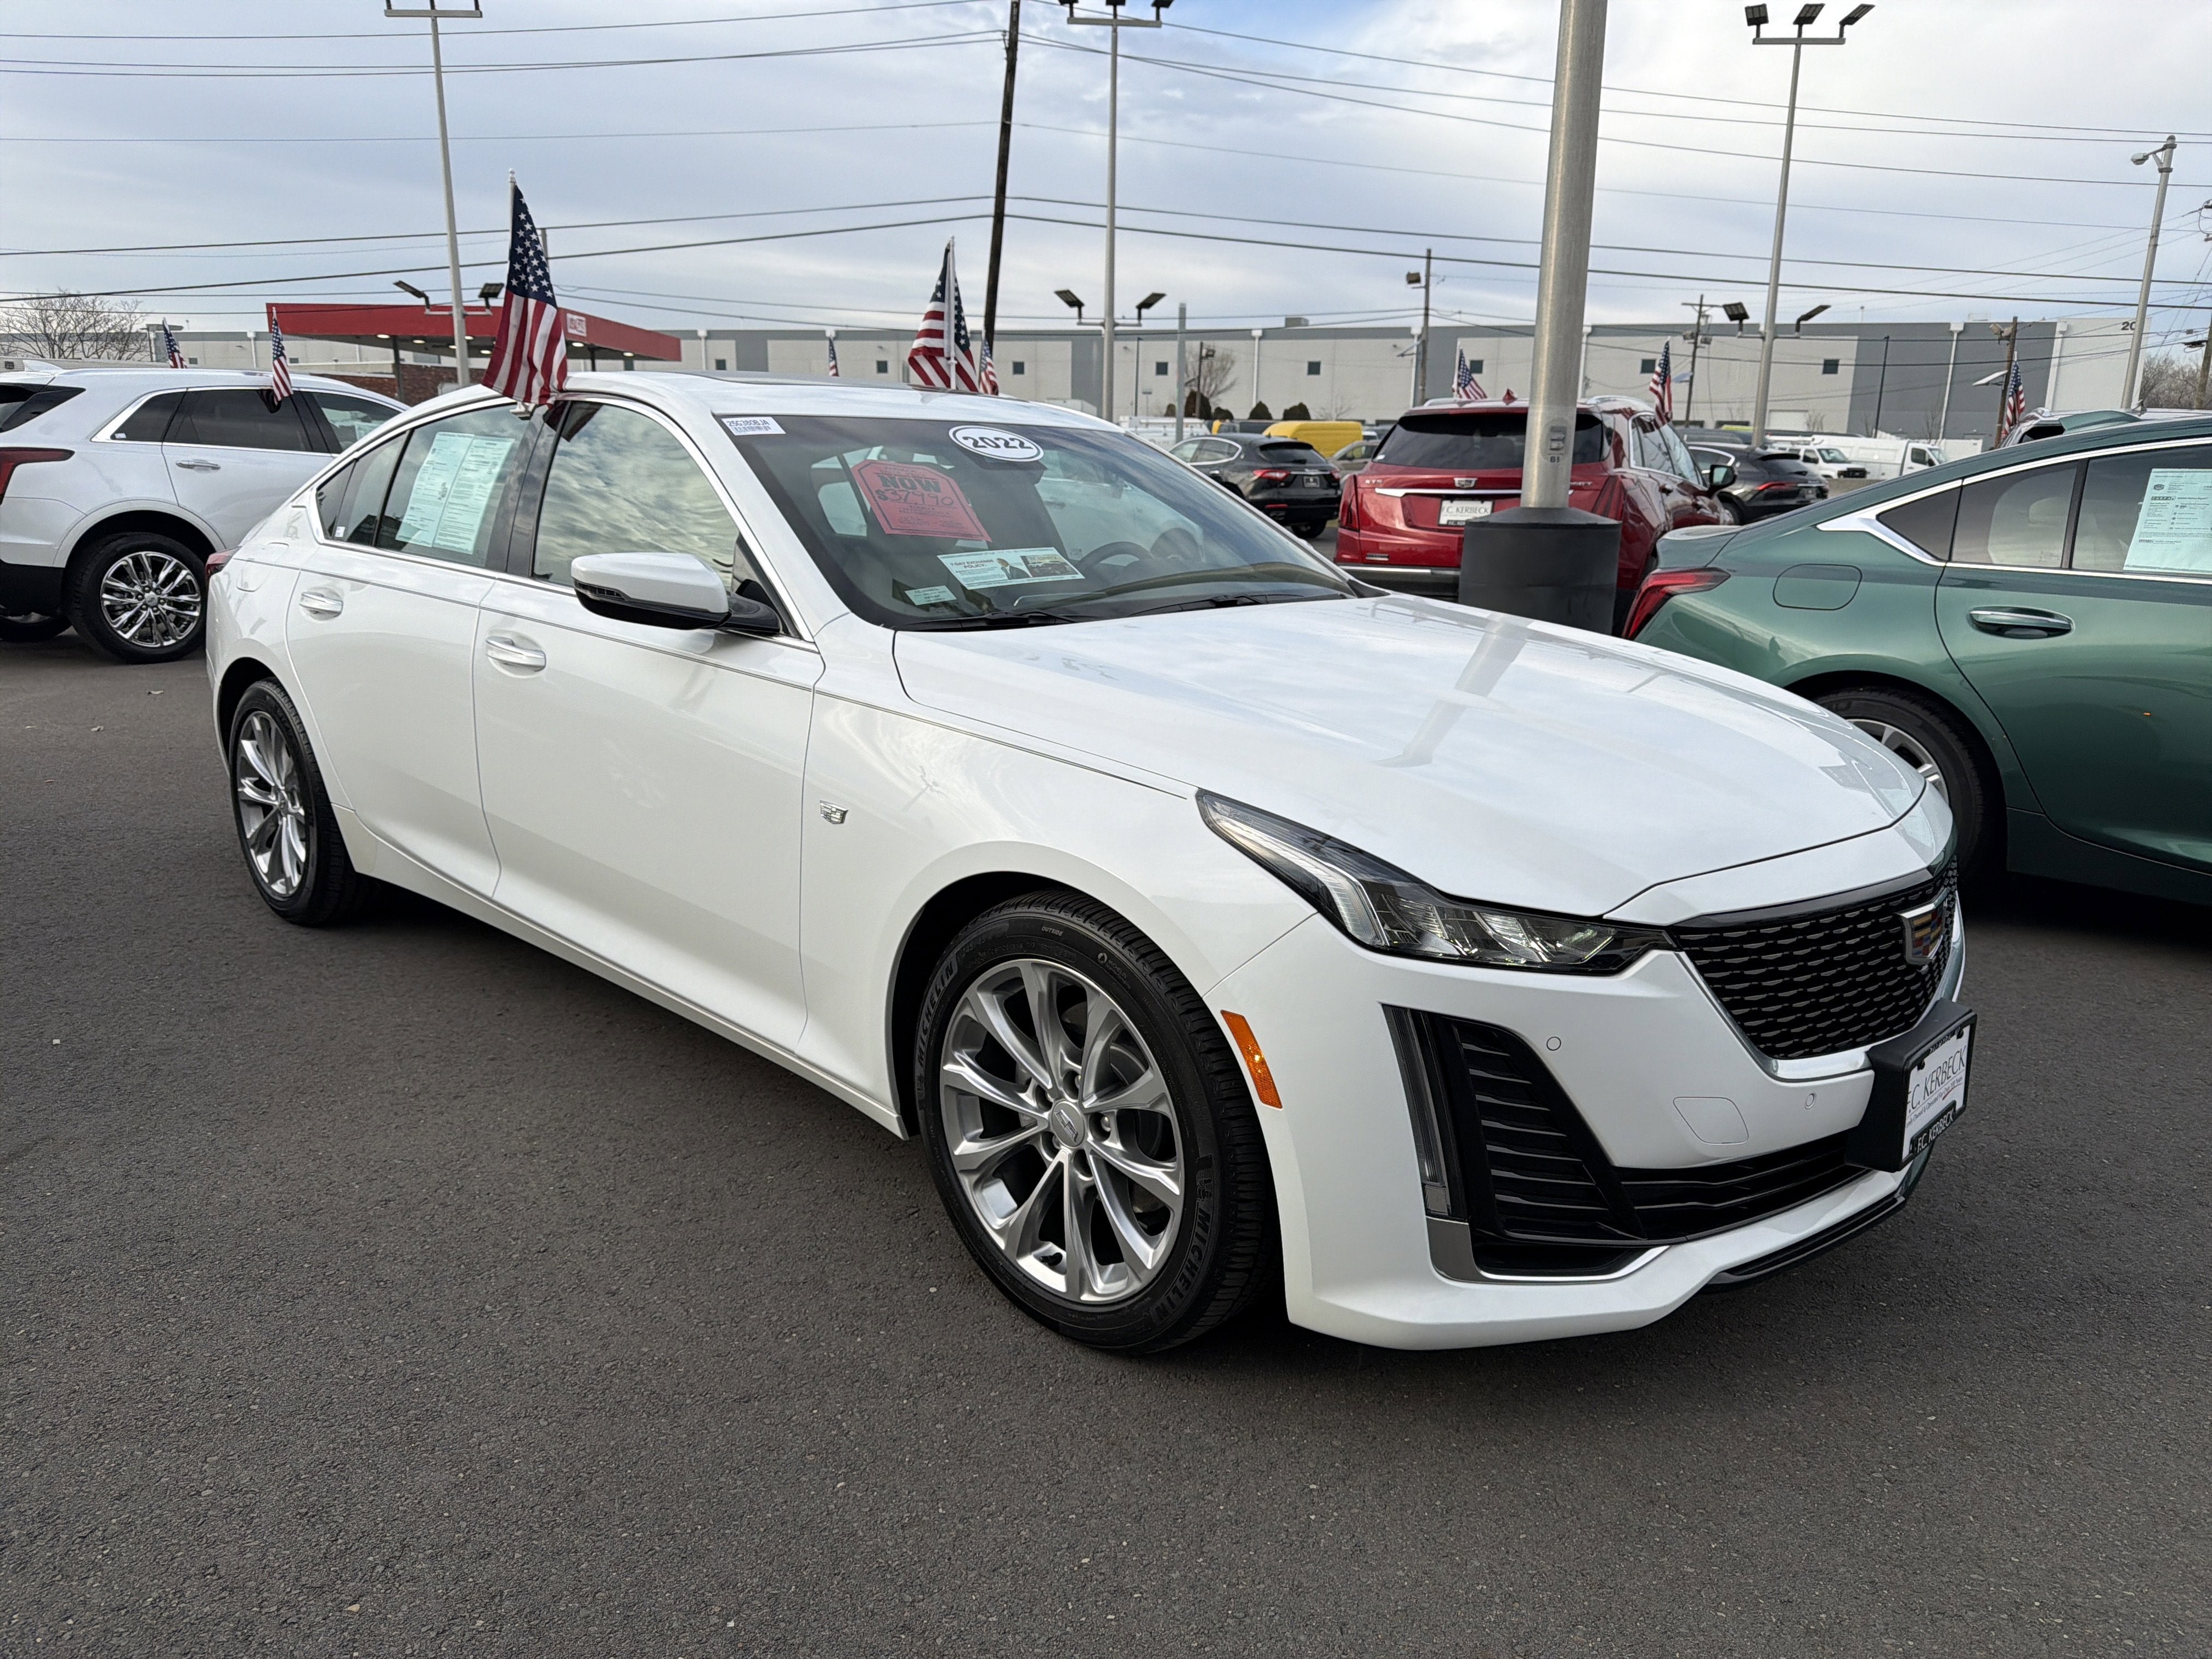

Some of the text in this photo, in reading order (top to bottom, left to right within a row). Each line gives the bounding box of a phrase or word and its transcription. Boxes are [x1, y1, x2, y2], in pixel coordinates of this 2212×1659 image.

[962, 436, 1034, 449] 2022
[878, 474, 941, 493] NOW
[1041, 926, 1064, 936] OUTSIDE
[916, 960, 955, 1068] MICHELIN
[1923, 1045, 1967, 1101] KERBECK
[1928, 1108, 1954, 1144] KERBECK
[1154, 1207, 1212, 1321] MICHELIN
